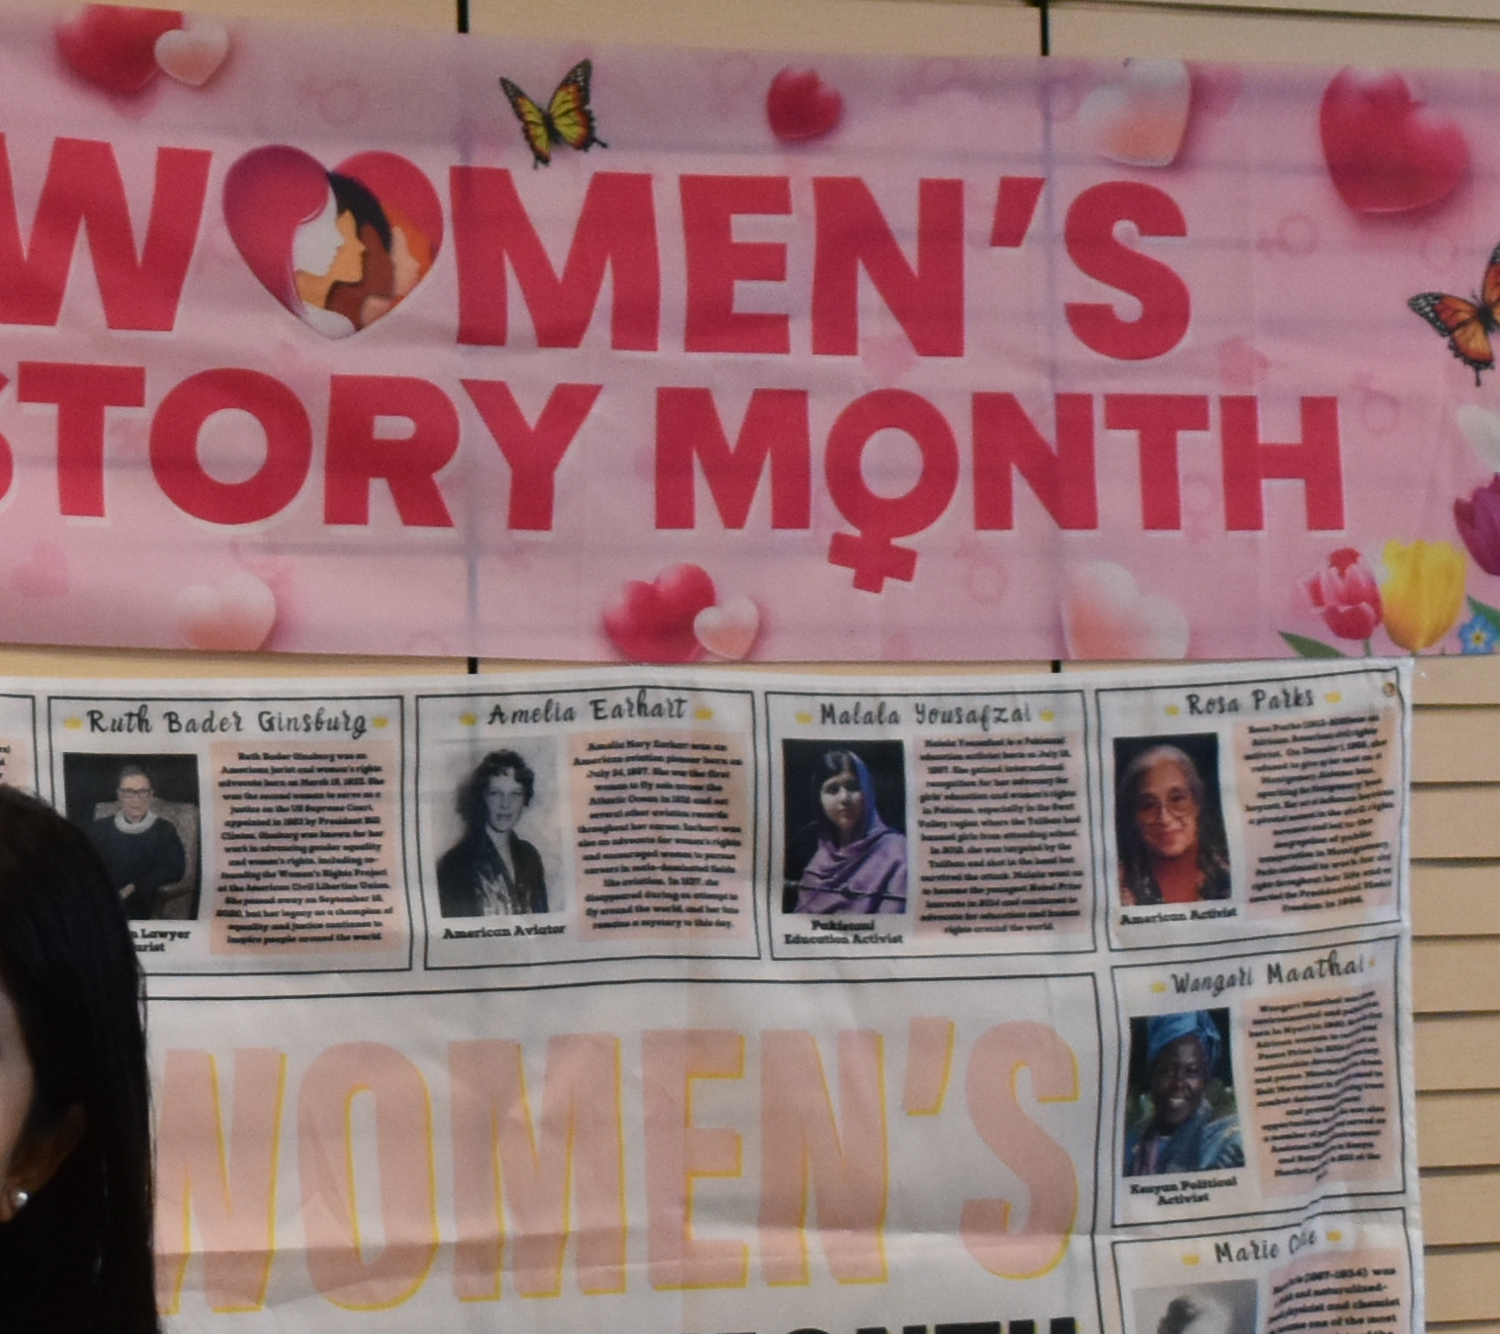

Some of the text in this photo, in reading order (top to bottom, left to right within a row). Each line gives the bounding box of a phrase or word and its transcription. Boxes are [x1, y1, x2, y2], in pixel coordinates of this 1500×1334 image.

[652, 388, 1347, 594] MONTH
[487, 689, 688, 725] Amelia Earhart
[1186, 688, 1315, 715] Rosa Parks
[87, 704, 367, 739] Ruth Bader Ginsburg
[819, 701, 1031, 732] Malala Yousafzai
[1120, 906, 1237, 926] American Activist
[141, 928, 191, 941] Lawyer
[442, 923, 567, 940] American Aviator
[784, 933, 903, 945] Education Activist
[1170, 949, 1365, 998] Wangari Maathai
[1214, 1239, 1280, 1263] Marie
